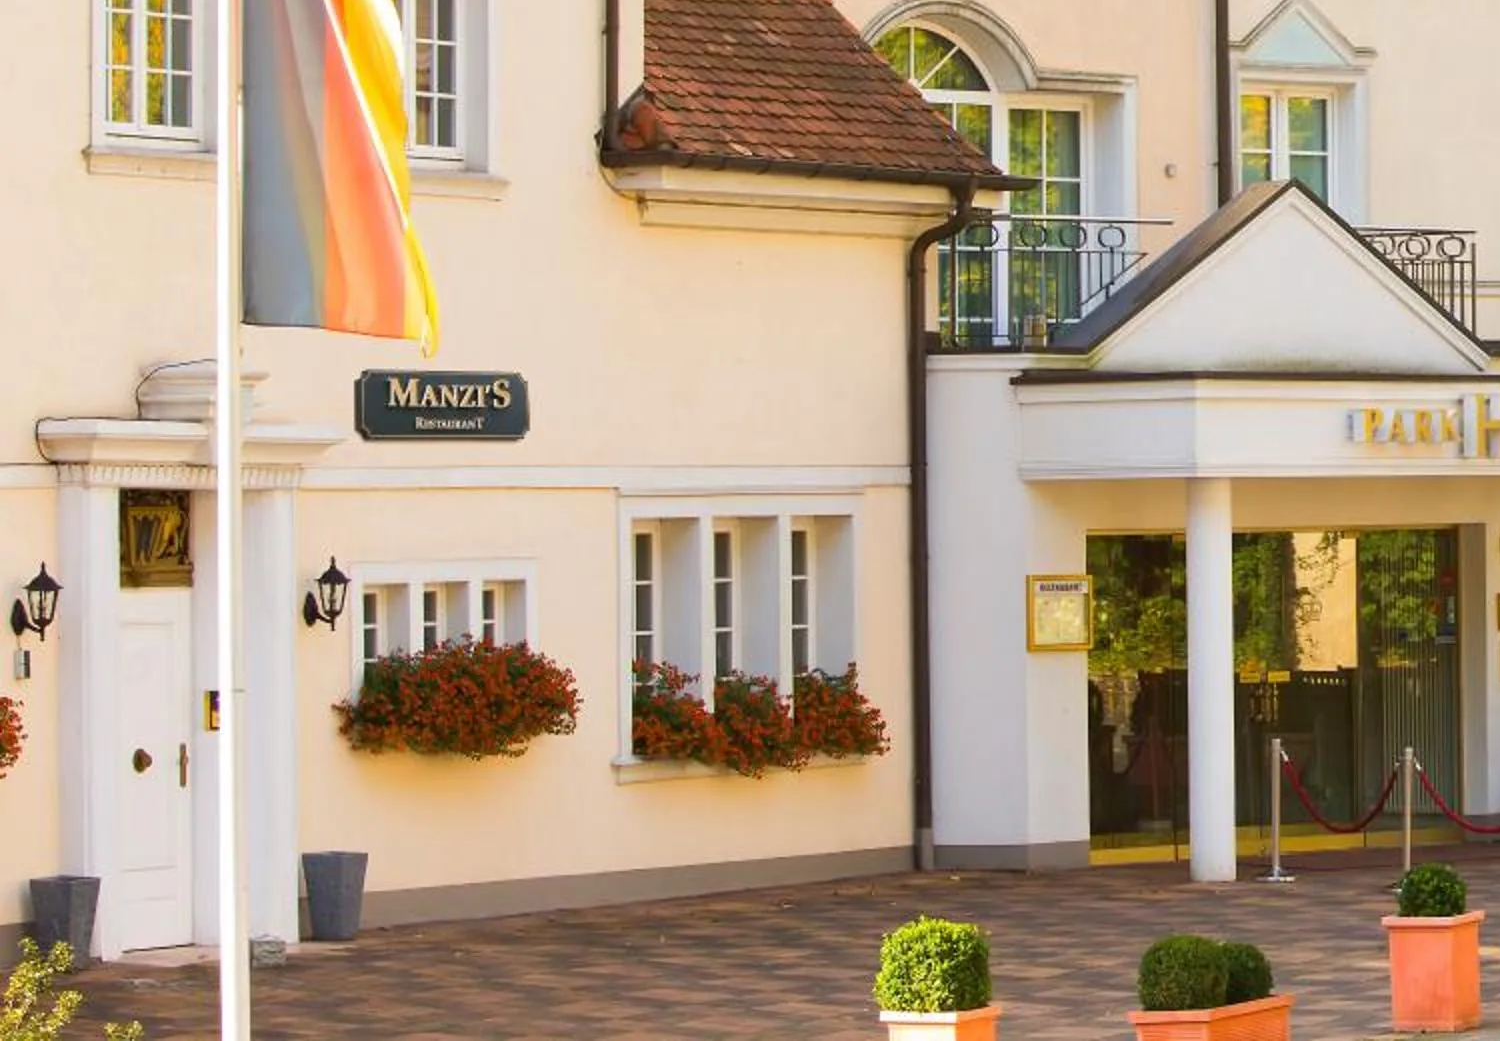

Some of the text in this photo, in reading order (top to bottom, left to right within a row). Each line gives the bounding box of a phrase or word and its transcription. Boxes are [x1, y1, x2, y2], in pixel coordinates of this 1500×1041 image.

[387, 377, 511, 409] MANZI'S
[415, 416, 484, 430] RESTAURANT
[1354, 408, 1464, 443] PARK
